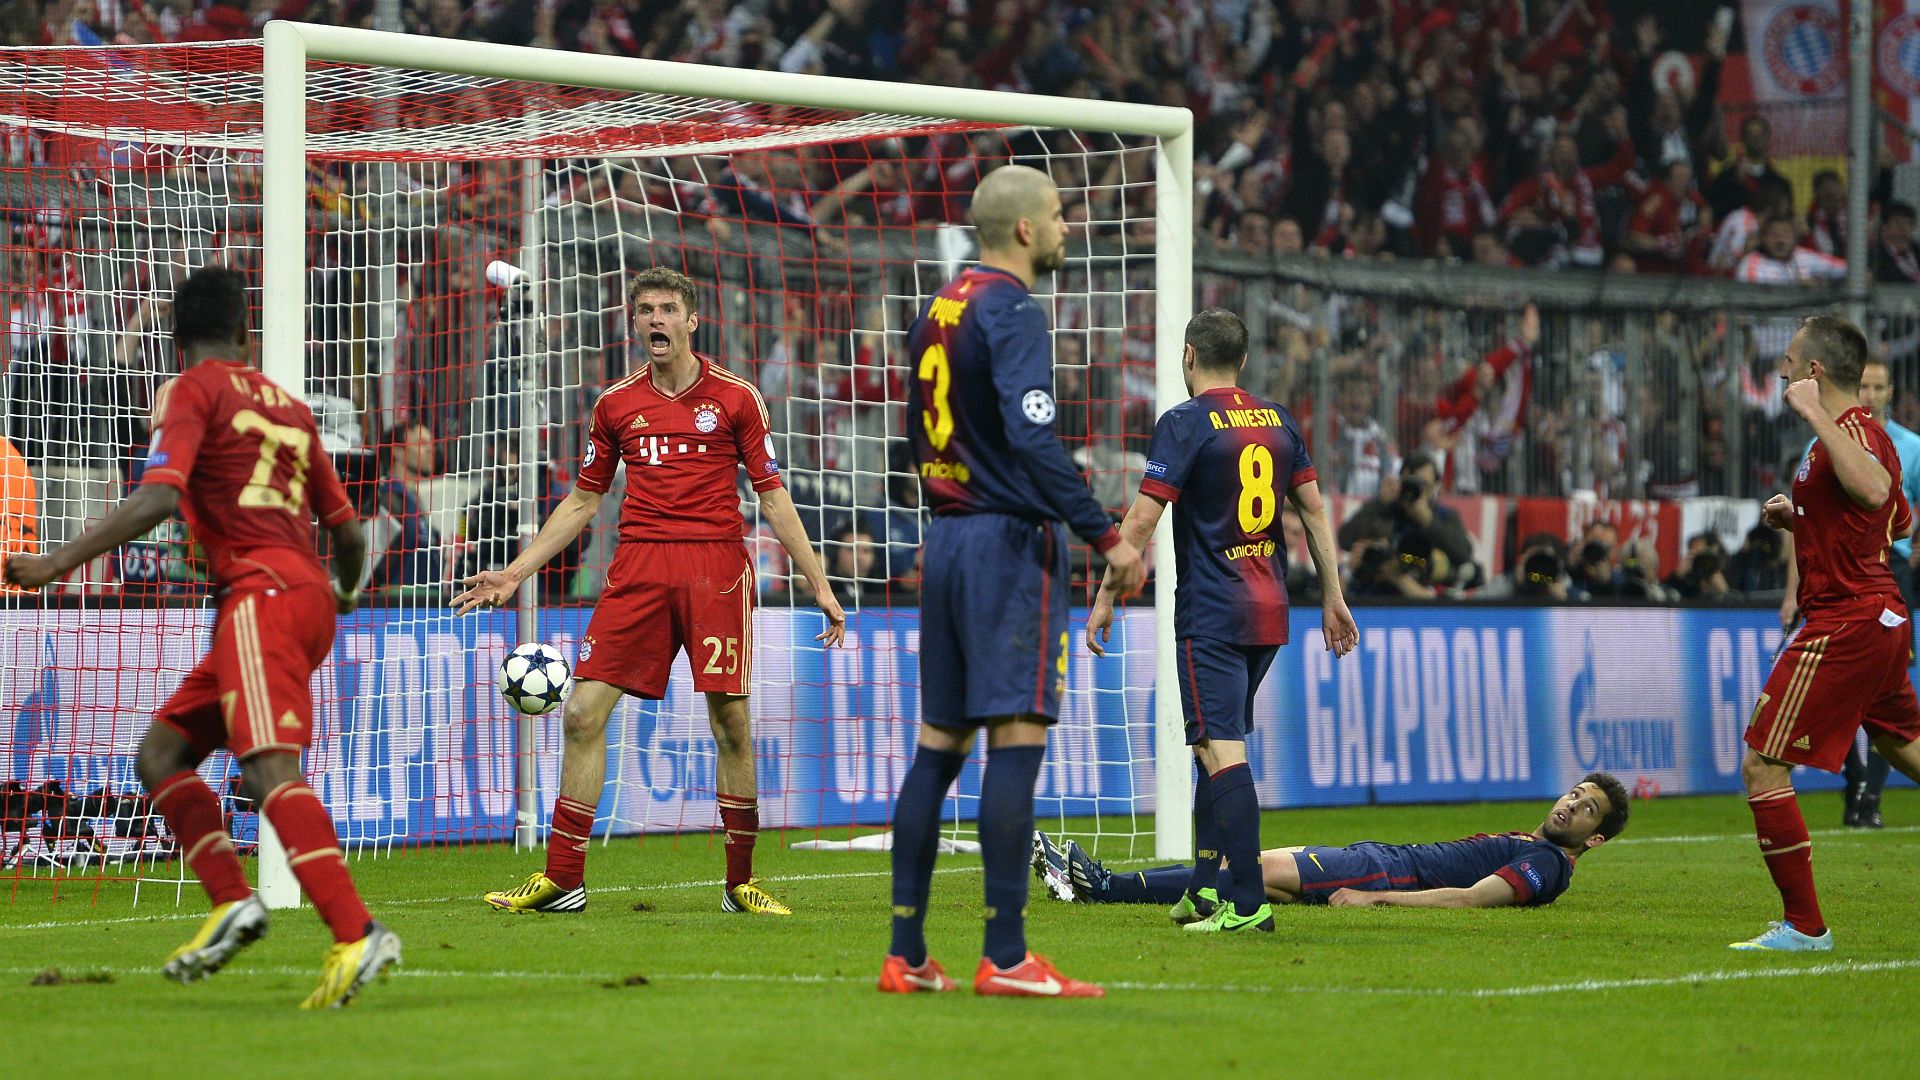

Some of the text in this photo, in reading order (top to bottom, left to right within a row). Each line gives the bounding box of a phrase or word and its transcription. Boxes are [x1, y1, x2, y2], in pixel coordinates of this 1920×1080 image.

[919, 343, 954, 451] 3
[1208, 408, 1282, 430] A. INIESTA
[231, 409, 311, 517] 27
[1238, 443, 1276, 535] 8
[1225, 541, 1265, 561] unicef
[702, 636, 738, 676] 25
[1304, 627, 1532, 788] GAZPROM
